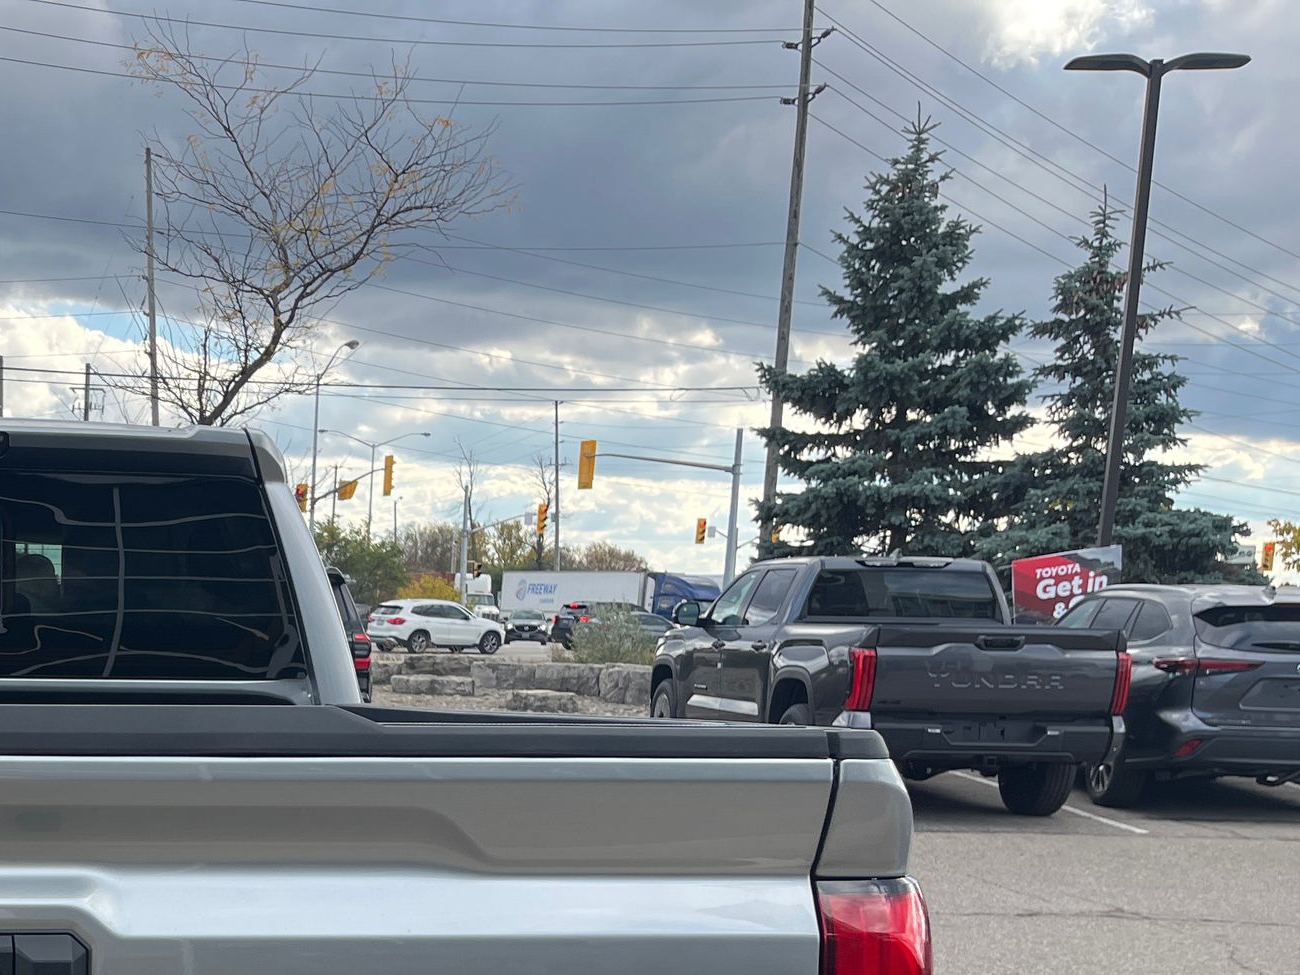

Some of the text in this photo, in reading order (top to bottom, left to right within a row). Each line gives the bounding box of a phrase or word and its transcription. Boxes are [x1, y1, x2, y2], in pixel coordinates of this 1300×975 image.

[1035, 563, 1081, 579] TOYOTA
[527, 583, 558, 595] FREEWAY
[1036, 570, 1108, 600] Get in
[927, 670, 1065, 690] TUNDRA
